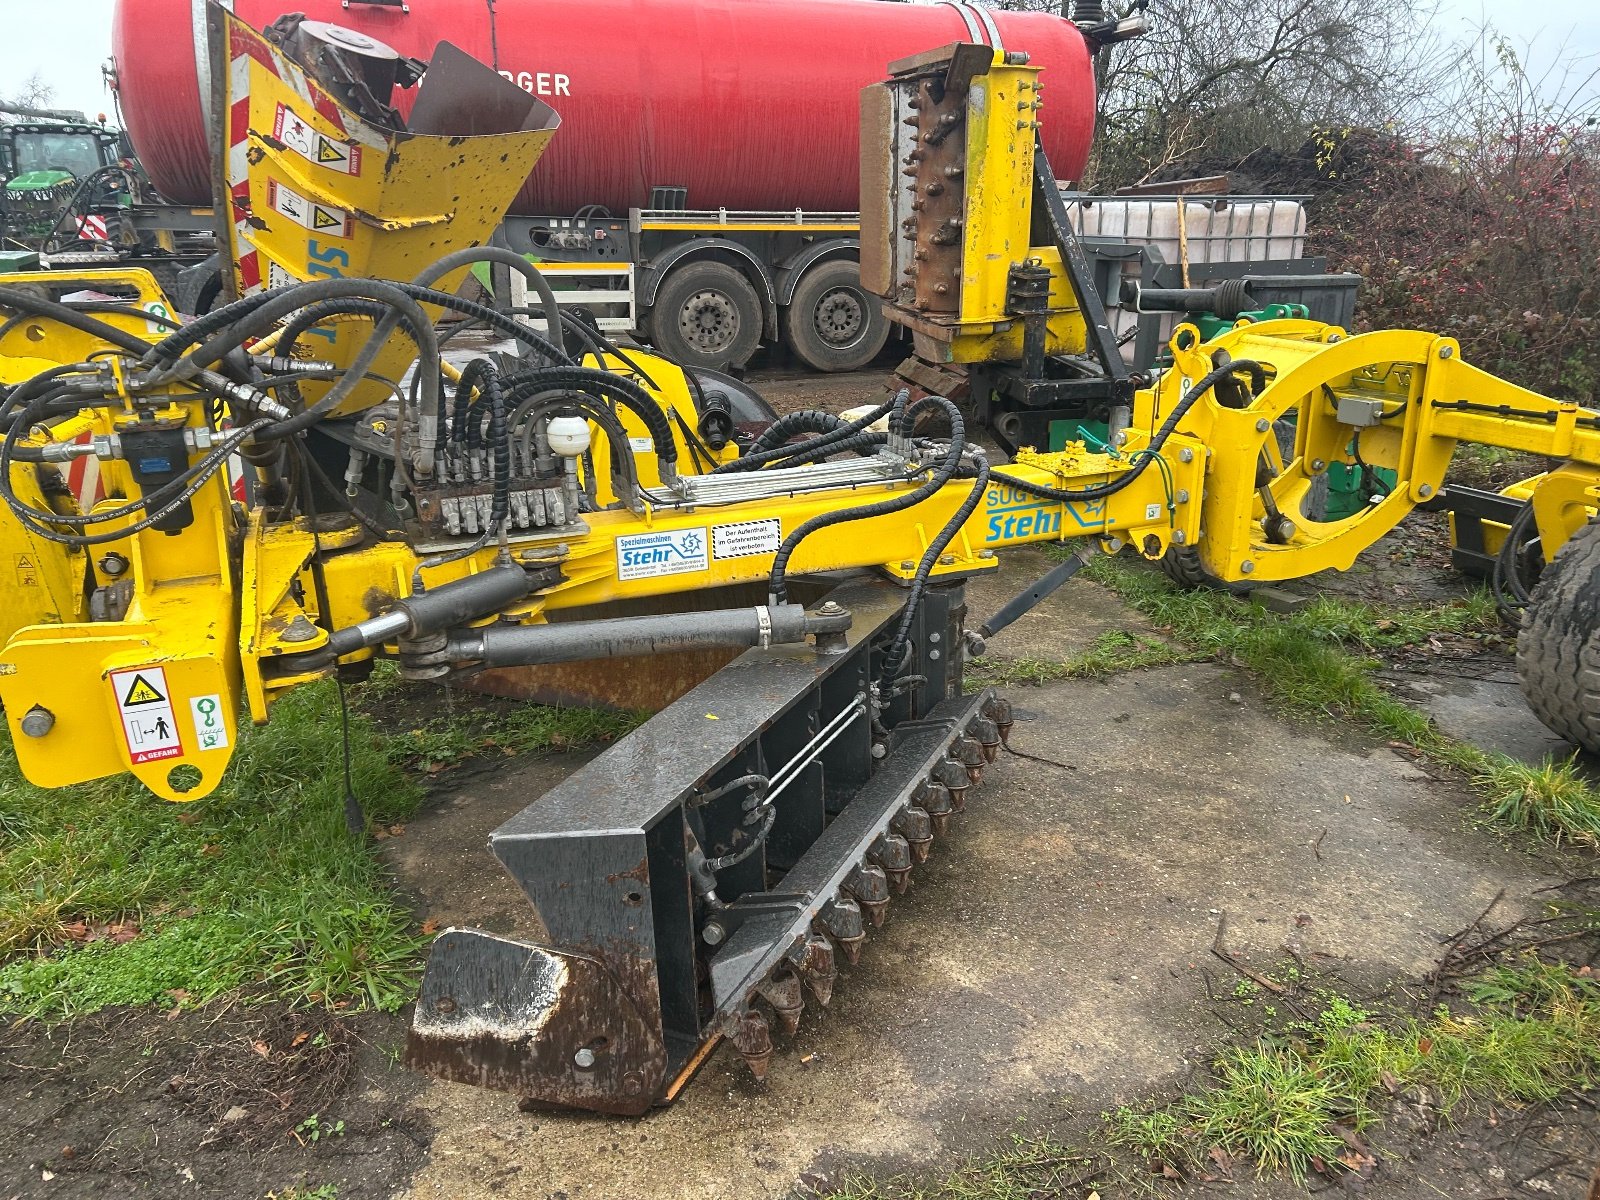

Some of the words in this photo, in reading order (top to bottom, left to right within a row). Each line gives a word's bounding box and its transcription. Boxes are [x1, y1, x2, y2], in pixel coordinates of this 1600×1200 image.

[737, 526, 768, 535] Aufenthalt
[621, 535, 672, 548] Spezialmaschinen
[726, 533, 776, 545] Gefahrenbereich
[738, 543, 765, 551] verboten
[622, 548, 673, 567] Stehr
[147, 748, 178, 760] GEFAHR
